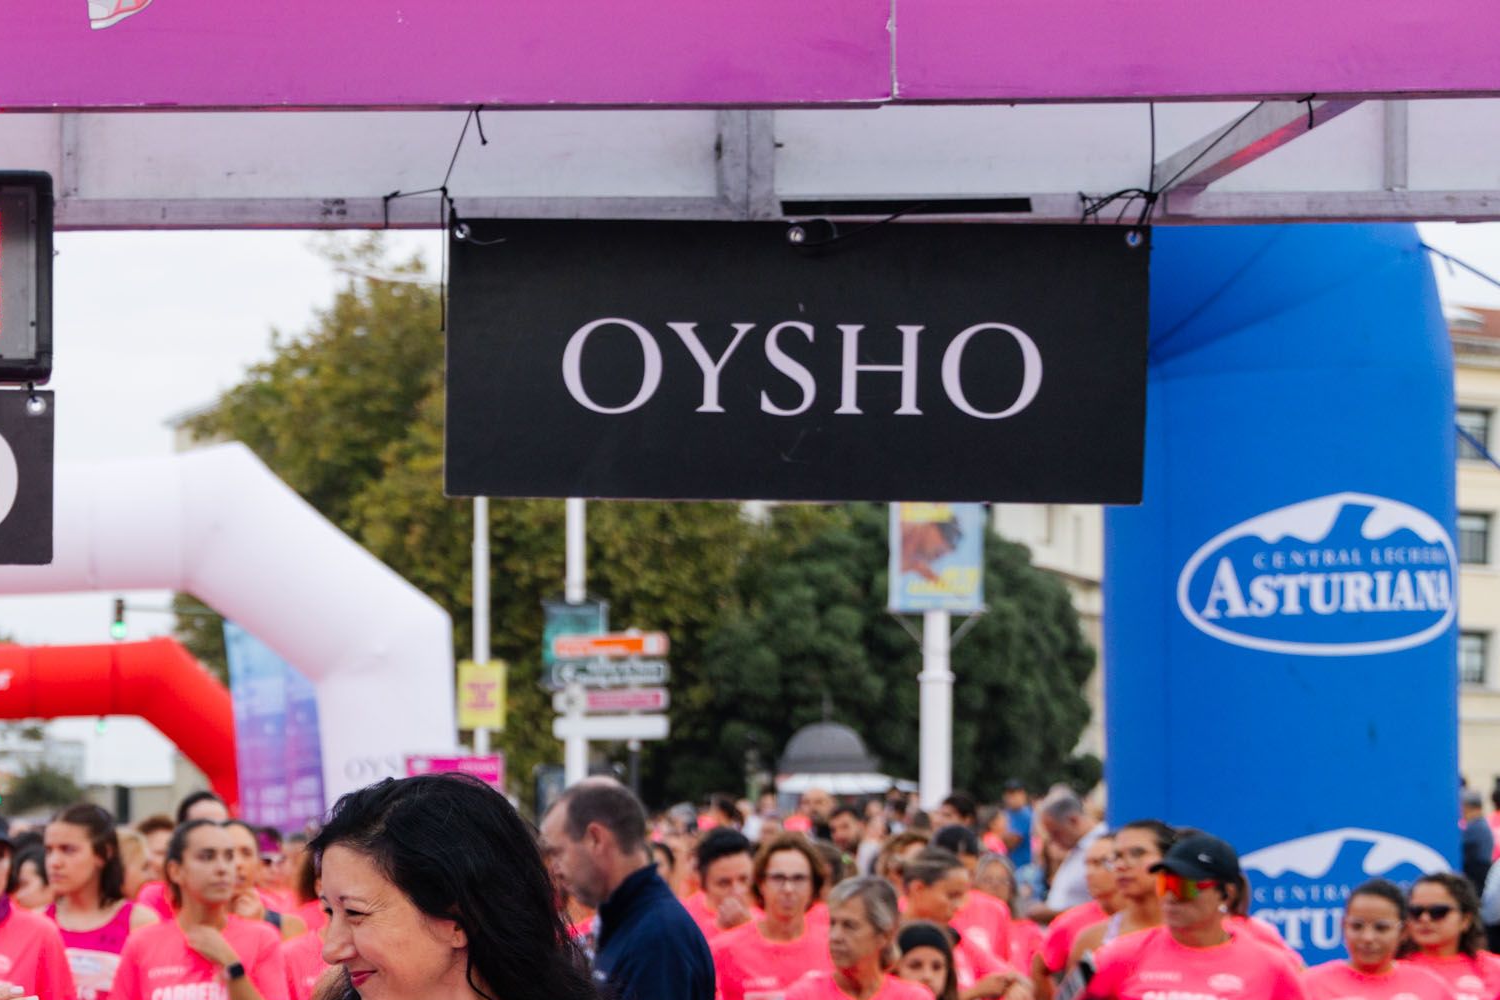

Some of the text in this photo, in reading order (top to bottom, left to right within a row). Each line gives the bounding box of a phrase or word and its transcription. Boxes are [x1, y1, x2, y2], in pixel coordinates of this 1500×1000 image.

[561, 316, 1044, 421] OYSHO
[1252, 547, 1362, 570] CENTRAL
[1252, 882, 1350, 902] CENTRA
